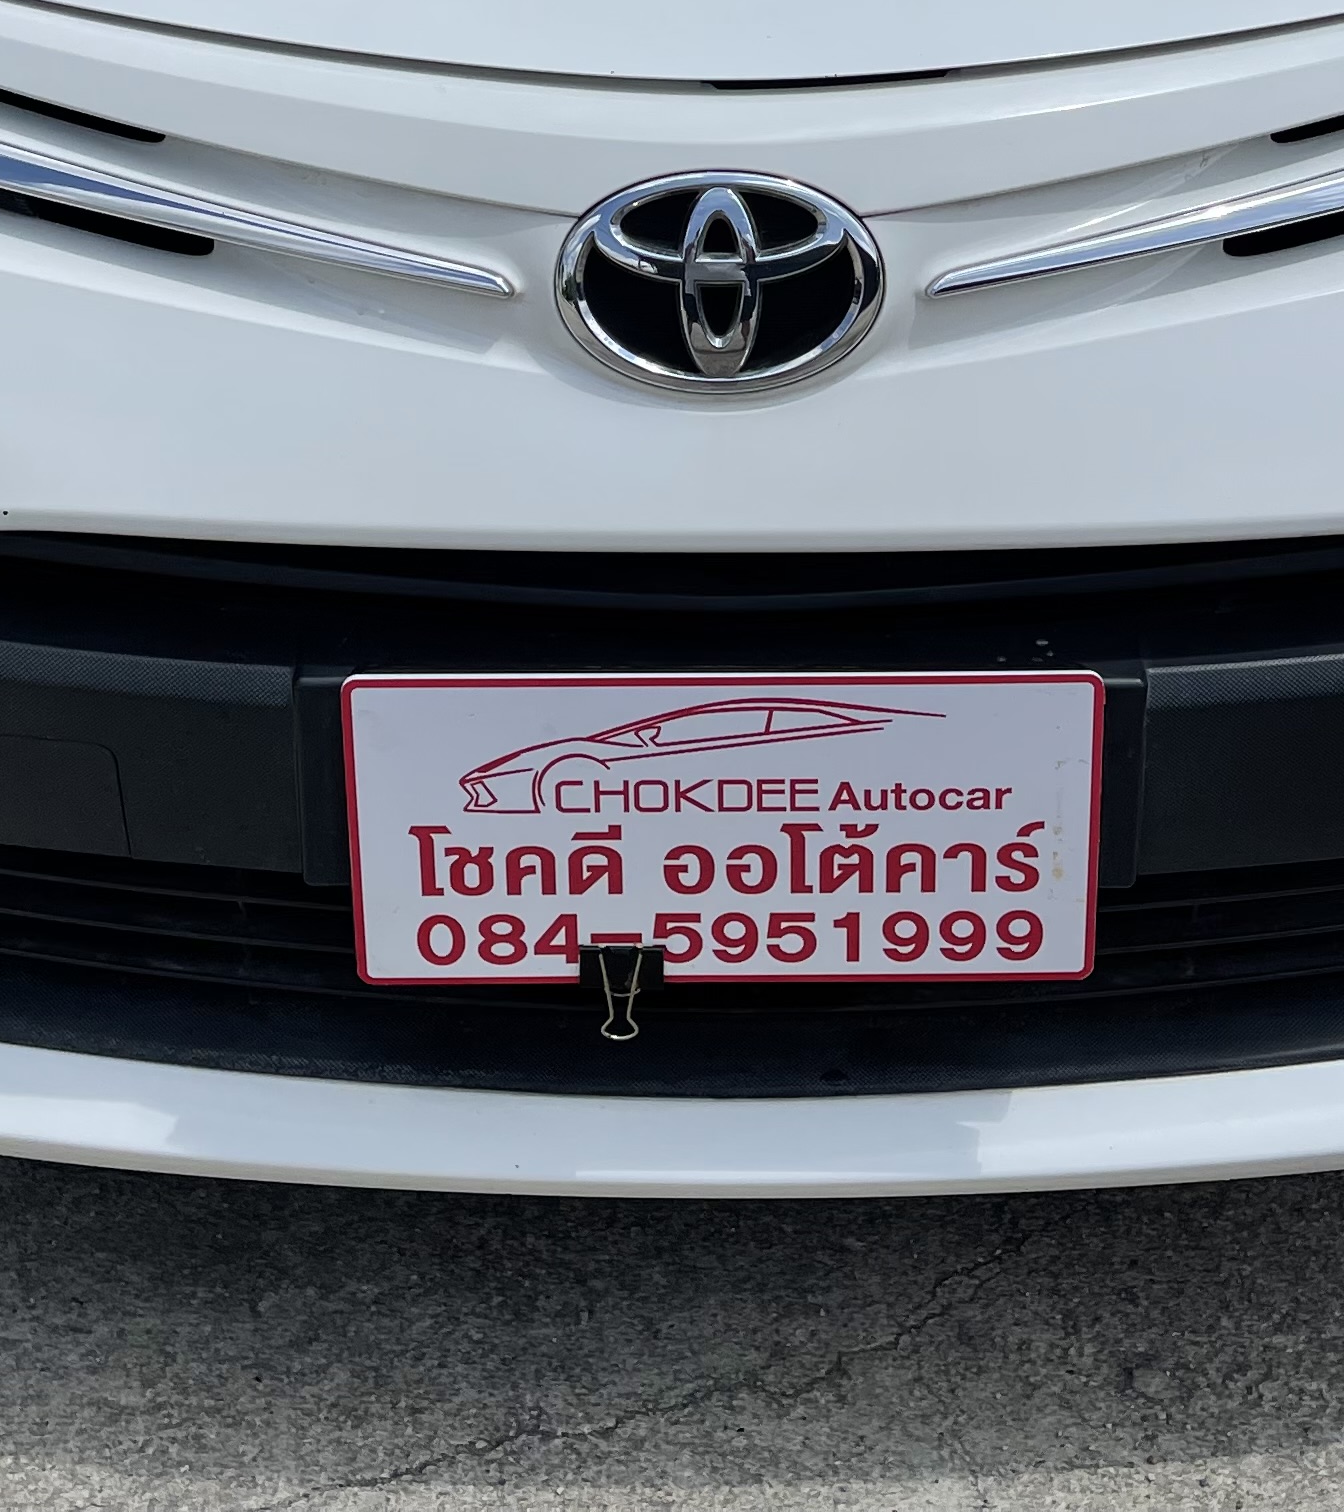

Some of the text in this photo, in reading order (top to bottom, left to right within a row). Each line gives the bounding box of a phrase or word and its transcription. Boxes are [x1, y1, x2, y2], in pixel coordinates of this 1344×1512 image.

[554, 777, 1013, 814] CHOKDEE Autocar
[408, 820, 1046, 897] โชคดี ออโต้คาร์
[416, 909, 1044, 967] 084-5951999
